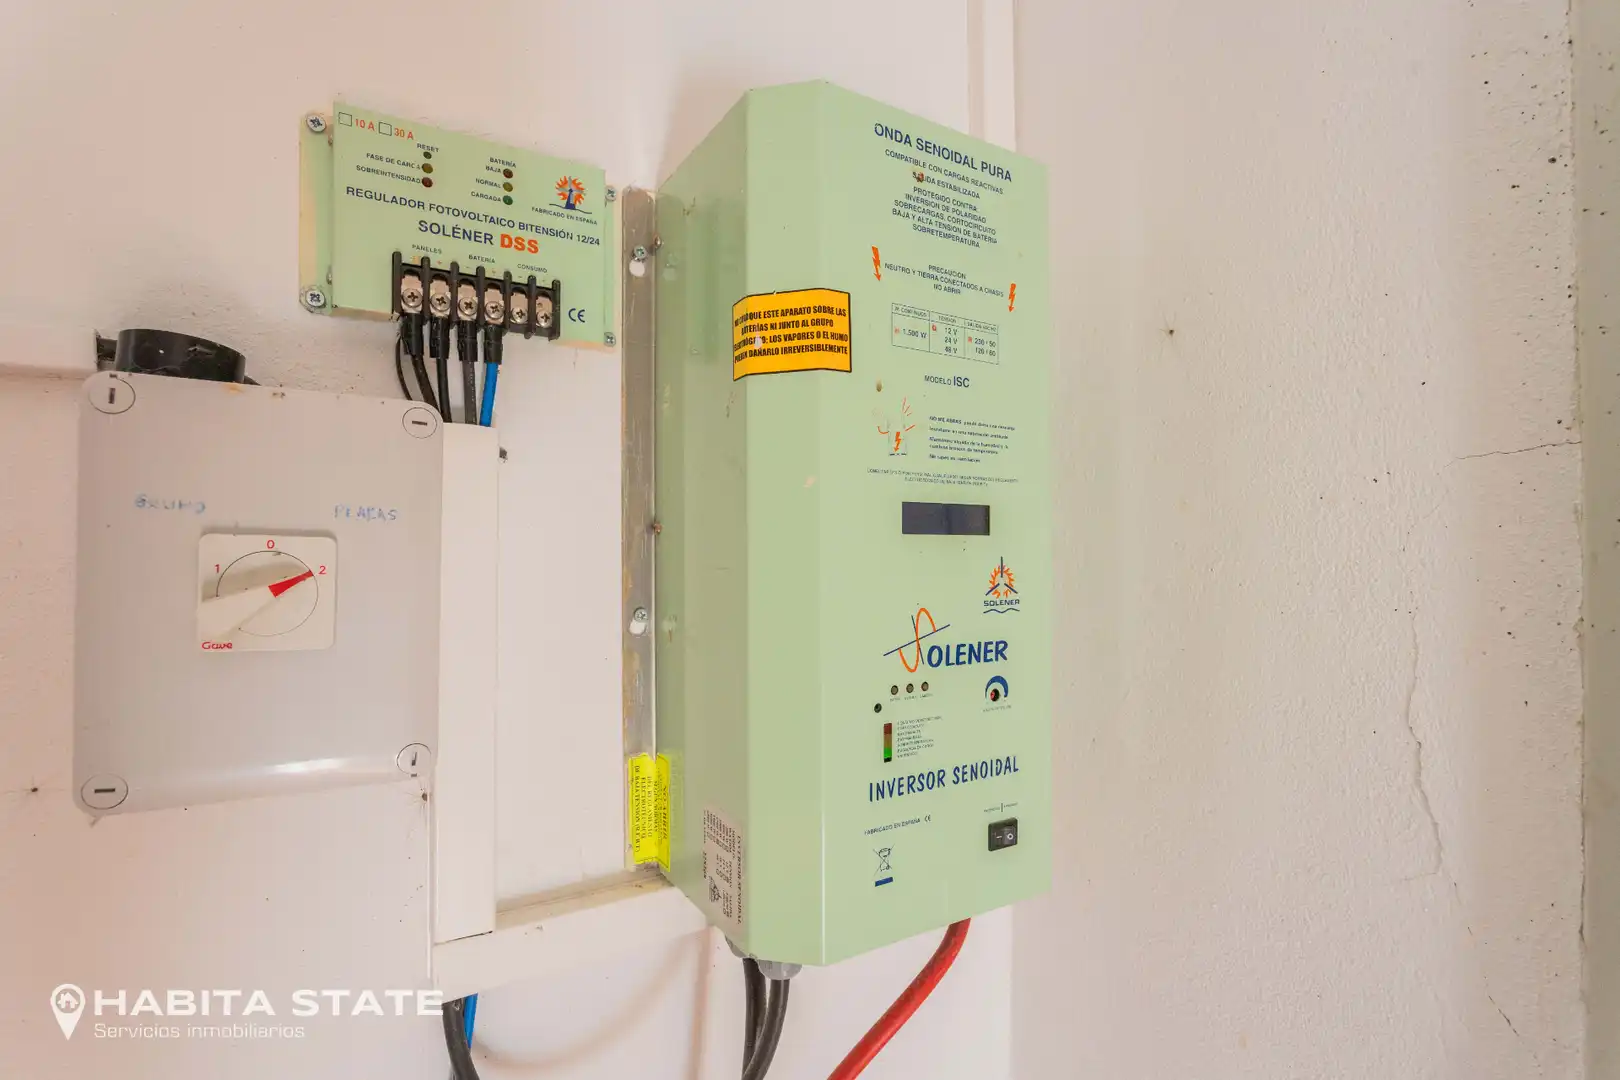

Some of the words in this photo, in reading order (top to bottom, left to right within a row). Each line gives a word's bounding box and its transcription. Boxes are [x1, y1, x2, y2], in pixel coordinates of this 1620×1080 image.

[356, 119, 365, 128] 10
[368, 122, 374, 131] A
[394, 128, 405, 137] 30
[407, 132, 414, 140] A
[417, 143, 439, 152] RESET
[874, 123, 912, 147] ONDA
[916, 138, 977, 170] SENOIDAL
[981, 161, 1012, 182] PURA
[367, 153, 384, 162] FASE
[490, 157, 516, 168] BATERÍA
[356, 165, 421, 183] SOBREINTENSIDAD
[885, 149, 926, 168] COMPATIBLE
[928, 163, 942, 174] CON
[944, 169, 969, 184] CARGAS
[971, 178, 1003, 195] REACTIVAS
[476, 178, 501, 188] NORMAL
[913, 187, 950, 204] PROTEGIDO
[937, 181, 980, 199] ESTABILIZADA
[471, 191, 501, 202] CARGADA
[346, 186, 424, 210] REGULADOR
[429, 203, 515, 228] FOTOVOLTAICO
[519, 222, 573, 240] BITENSIÓN
[577, 235, 600, 246] 12/24
[532, 207, 564, 218] FABRICADO
[576, 216, 597, 225] ESPAÑA
[892, 208, 910, 219] BAJA
[918, 216, 933, 226] ALTA
[963, 228, 971, 236] DE
[952, 208, 986, 224] POLARIDAD
[947, 215, 996, 235] CORTOCIRCUITO
[418, 220, 494, 245] SOLÉNER
[500, 234, 538, 254] DSS
[913, 224, 980, 248] SOBRETEMPERATURA
[412, 244, 442, 255] PANELES
[468, 254, 496, 264] BATERÍA
[517, 263, 547, 274] CONSUMO
[885, 263, 910, 275] NEUTRO
[918, 271, 939, 282] TIERRA
[940, 276, 978, 291] CONECTADOS
[984, 287, 1003, 297] CHASIS
[944, 286, 960, 295] ABRIR
[568, 308, 585, 323] CE
[763, 310, 779, 318] ESTE
[781, 306, 811, 317] APARATO
[813, 306, 834, 314] SOBRE
[836, 308, 846, 317] LAS
[779, 320, 800, 329] JUNTO
[811, 318, 833, 327] GRUPO
[770, 335, 781, 343] LOS
[783, 332, 814, 341] VAPORES
[831, 332, 848, 342] HUMO
[749, 346, 779, 357] DAÑARLO
[781, 344, 847, 354] IRREVERSIBLEMENTE
[925, 375, 951, 385] MODELO
[954, 376, 969, 387] ISC
[267, 540, 274, 549] 0
[215, 564, 220, 573] 1
[318, 566, 326, 574] 2
[869, 769, 946, 802] INVERSOR
[952, 756, 1019, 785] SENOIDAL
[864, 824, 893, 835] FABRICADO
[902, 818, 920, 827] ESPAÑA
